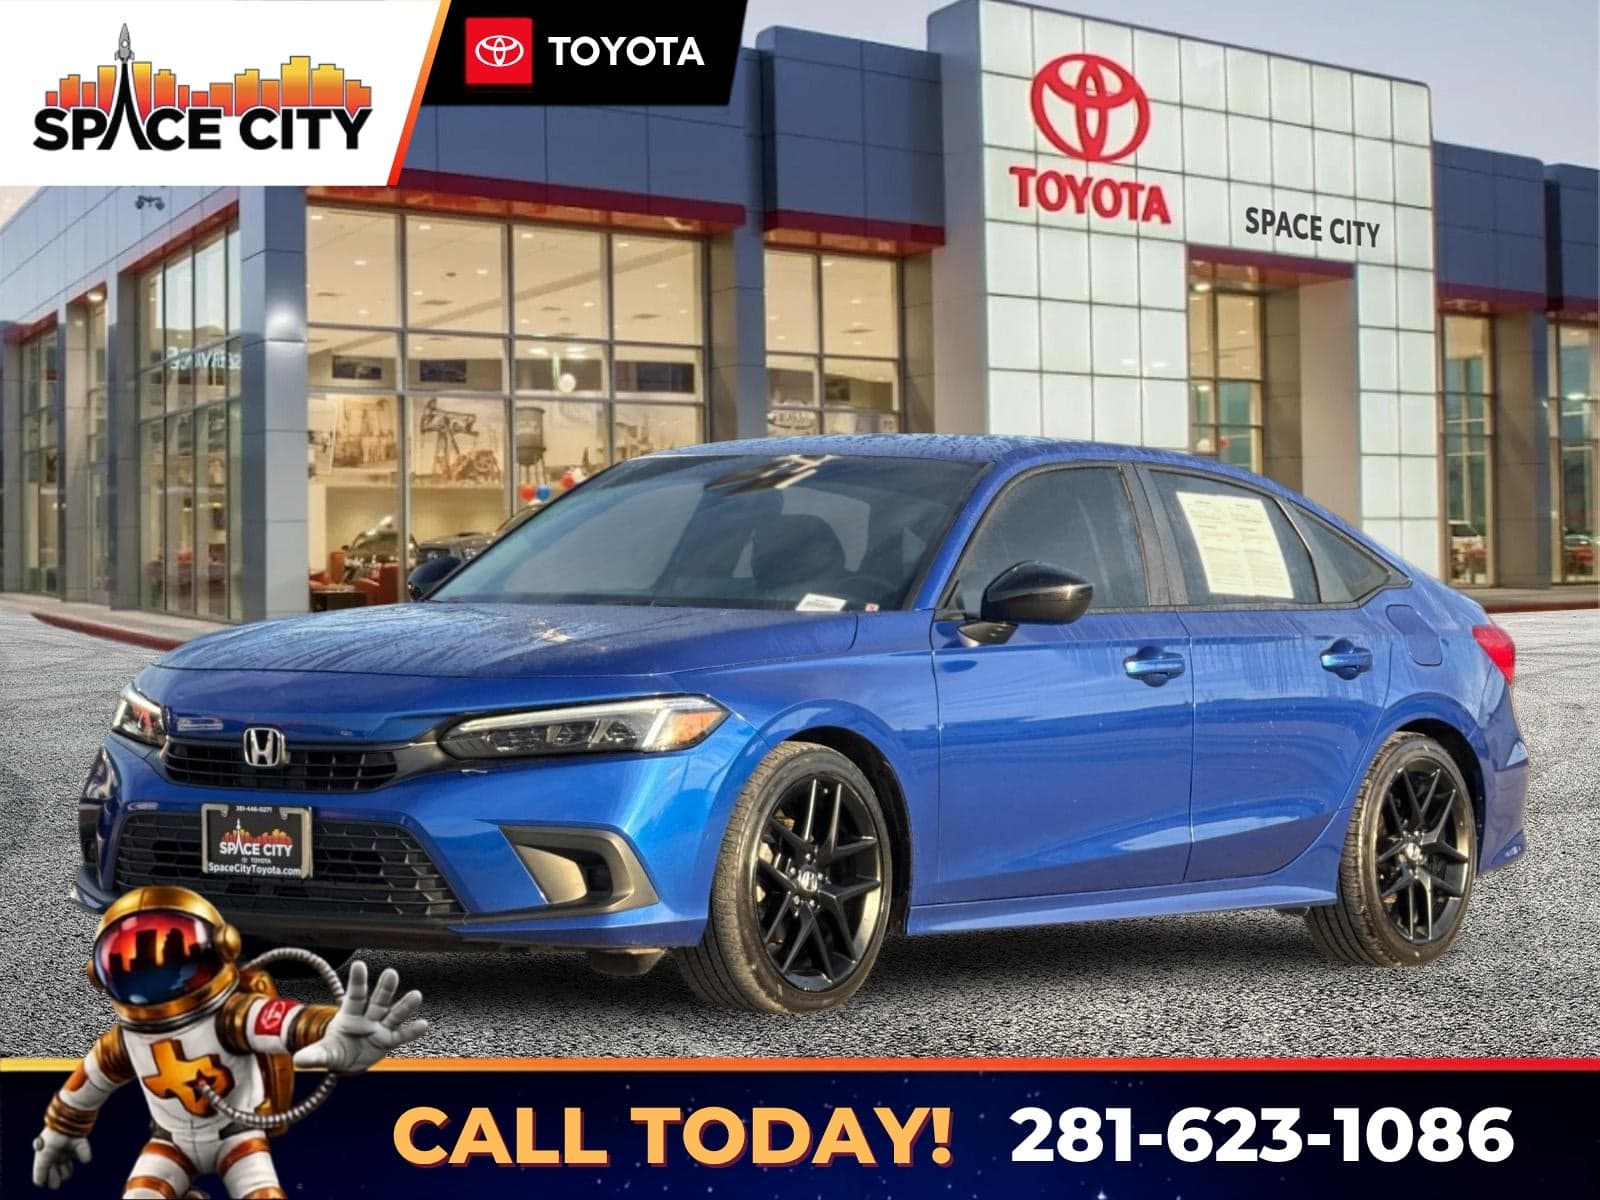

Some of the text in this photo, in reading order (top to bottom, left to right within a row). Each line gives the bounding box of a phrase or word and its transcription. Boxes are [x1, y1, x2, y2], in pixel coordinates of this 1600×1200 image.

[1009, 166, 1171, 224] TOYOTA
[1245, 206, 1381, 248] SPACE CITY
[219, 841, 293, 857] SPACE CITY
[208, 862, 301, 876] SpaceCityToyota.com
